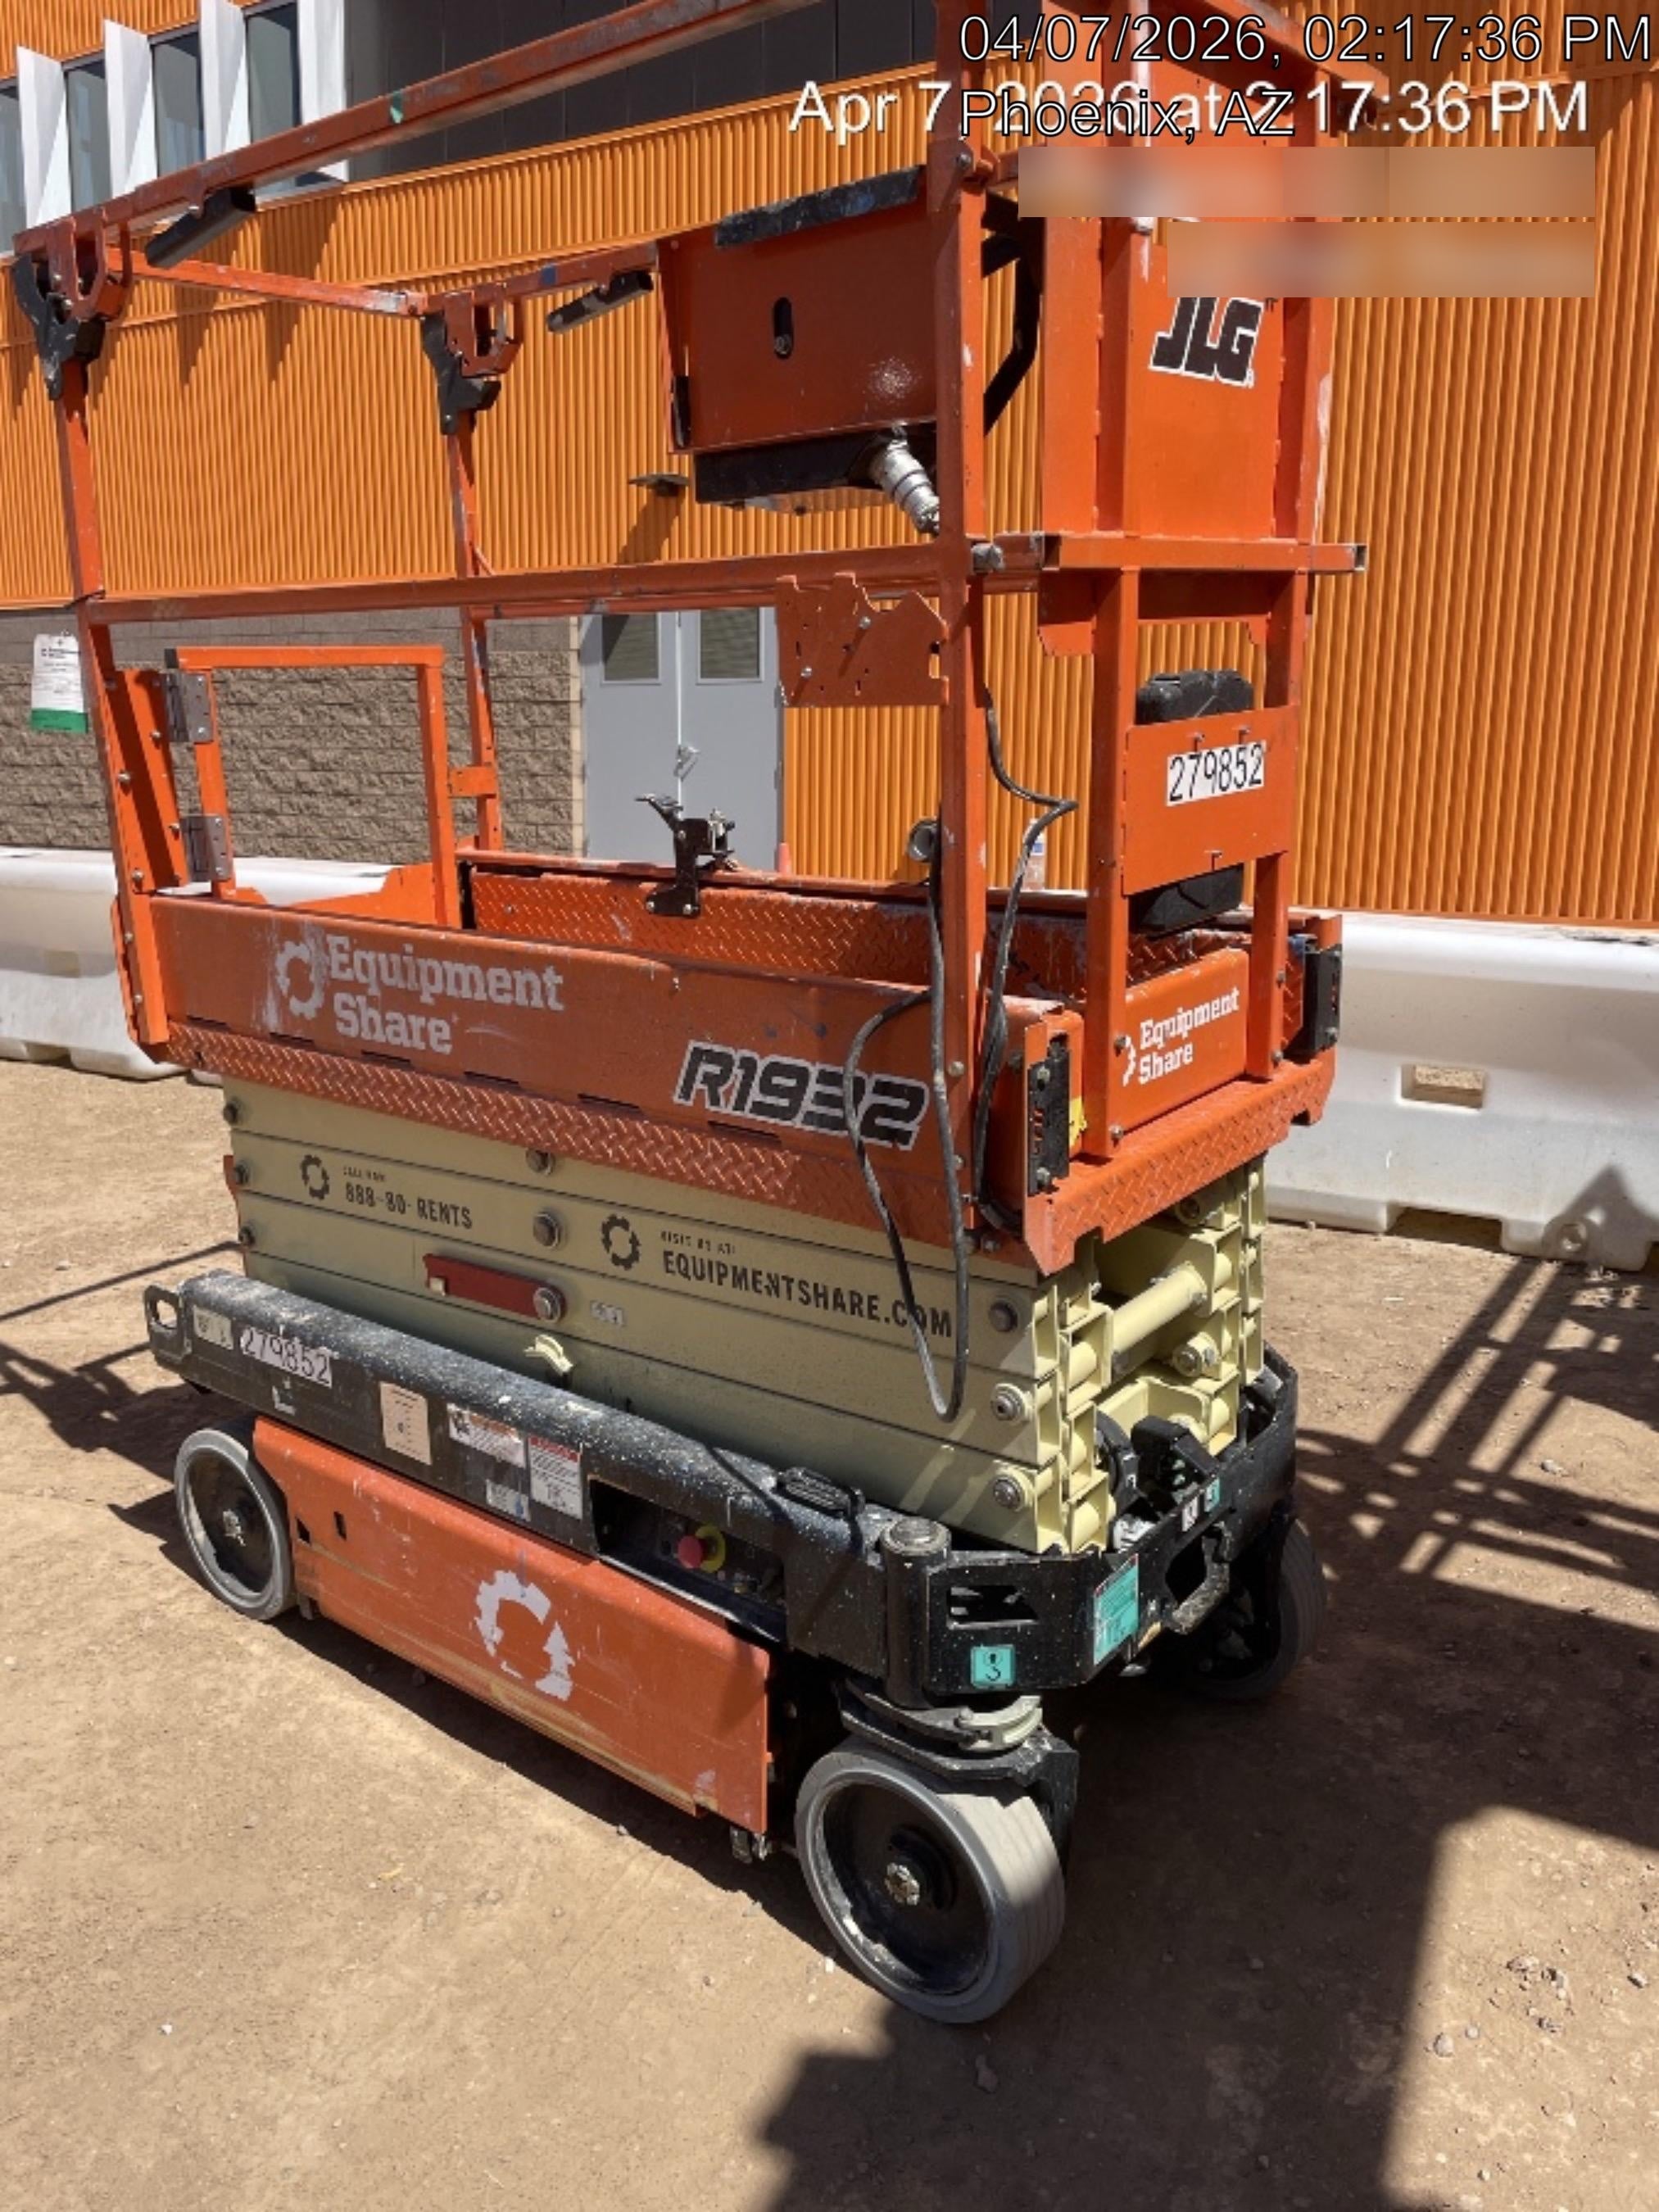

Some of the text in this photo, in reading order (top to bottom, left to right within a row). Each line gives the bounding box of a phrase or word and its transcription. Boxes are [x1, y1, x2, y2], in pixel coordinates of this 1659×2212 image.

[1149, 297, 1265, 388] JLG
[1169, 744, 1262, 802] 279852
[329, 936, 565, 1011] Equipment
[333, 991, 453, 1055] Share
[1140, 986, 1240, 1049] Equipment
[673, 1040, 930, 1150] R1932
[1138, 1044, 1194, 1085] Share
[662, 1249, 952, 1338] EQUIPMENTSHARE.COM
